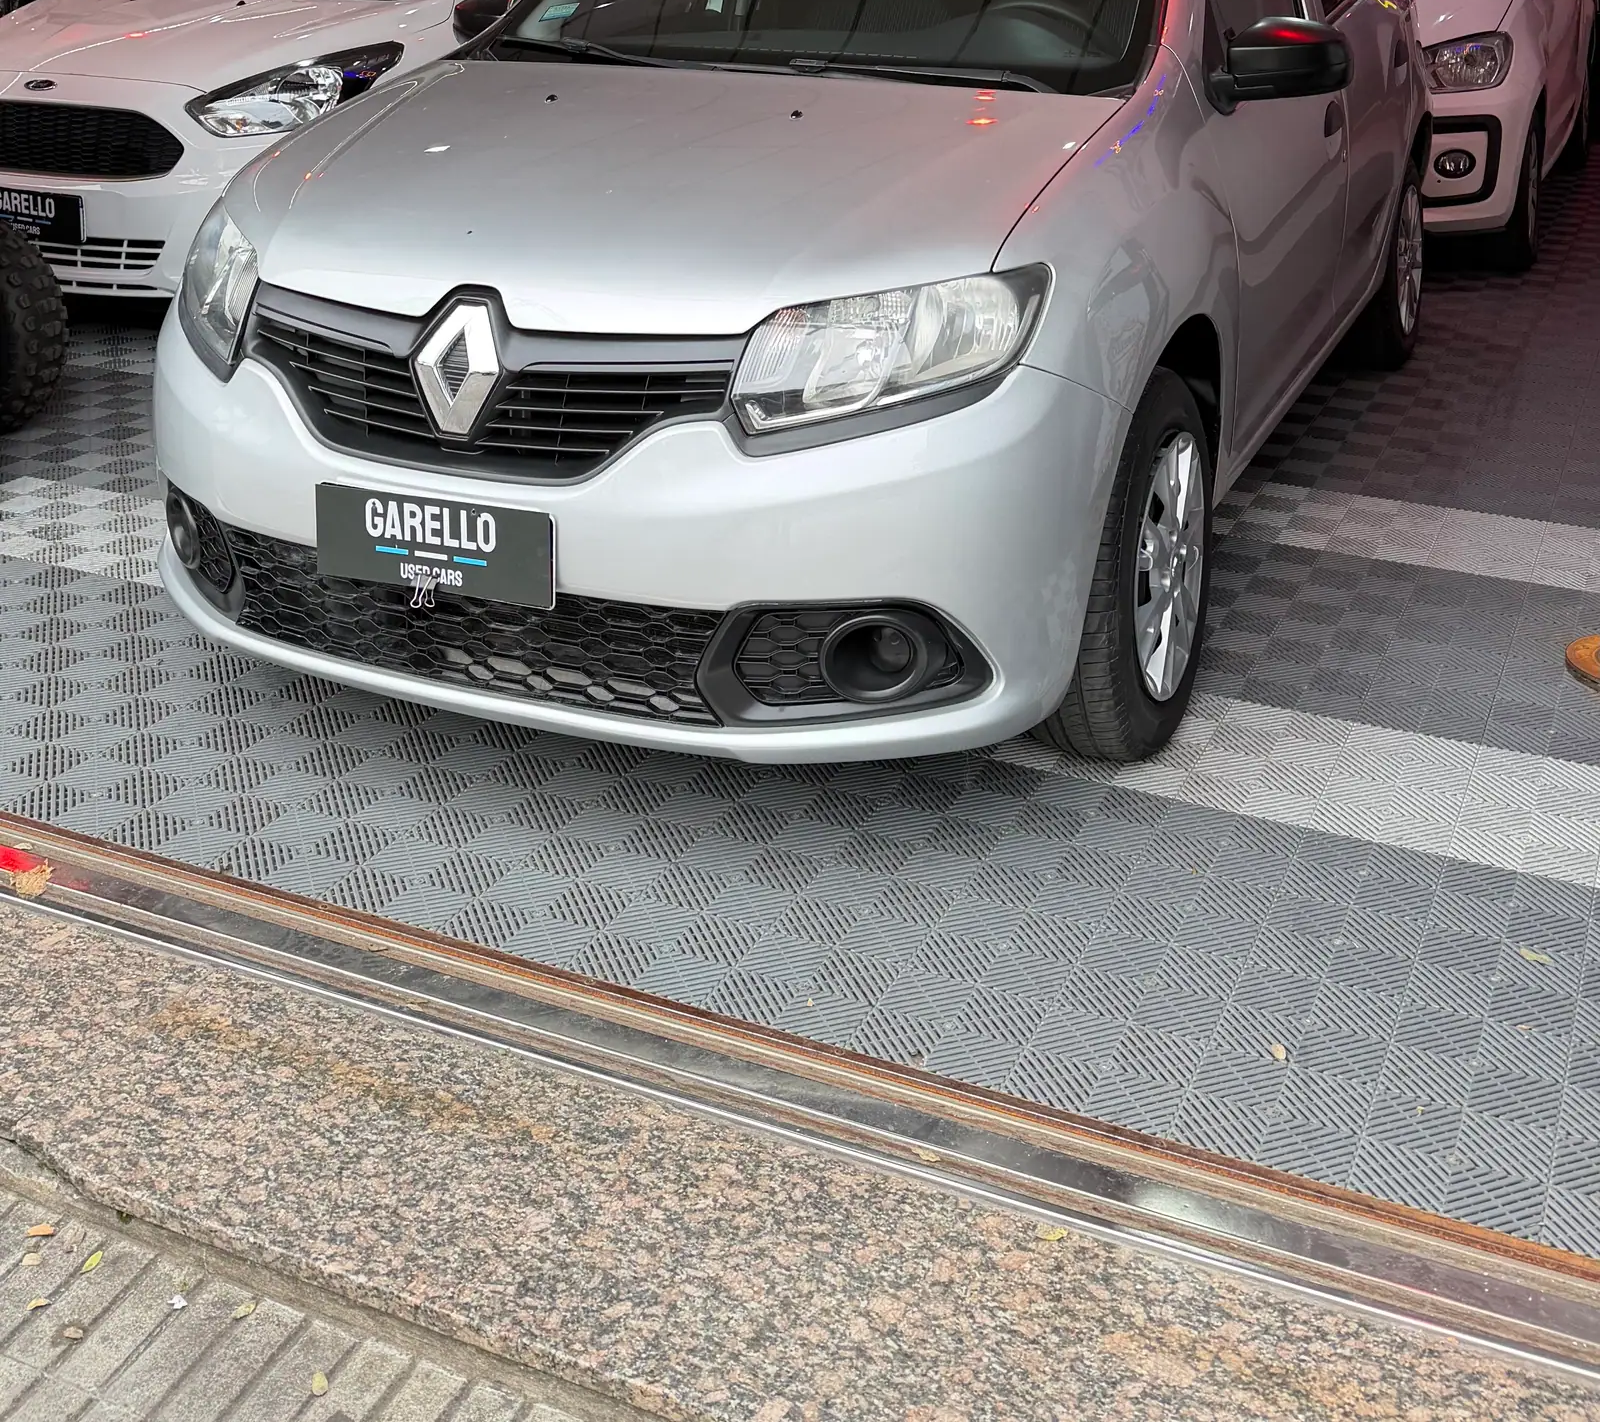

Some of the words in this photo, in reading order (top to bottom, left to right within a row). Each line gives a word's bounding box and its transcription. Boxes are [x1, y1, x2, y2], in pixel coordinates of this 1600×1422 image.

[0, 190, 55, 219] ARELLO
[364, 497, 497, 553] GARELLO
[400, 562, 431, 580] USED
[432, 566, 463, 587] CARS
